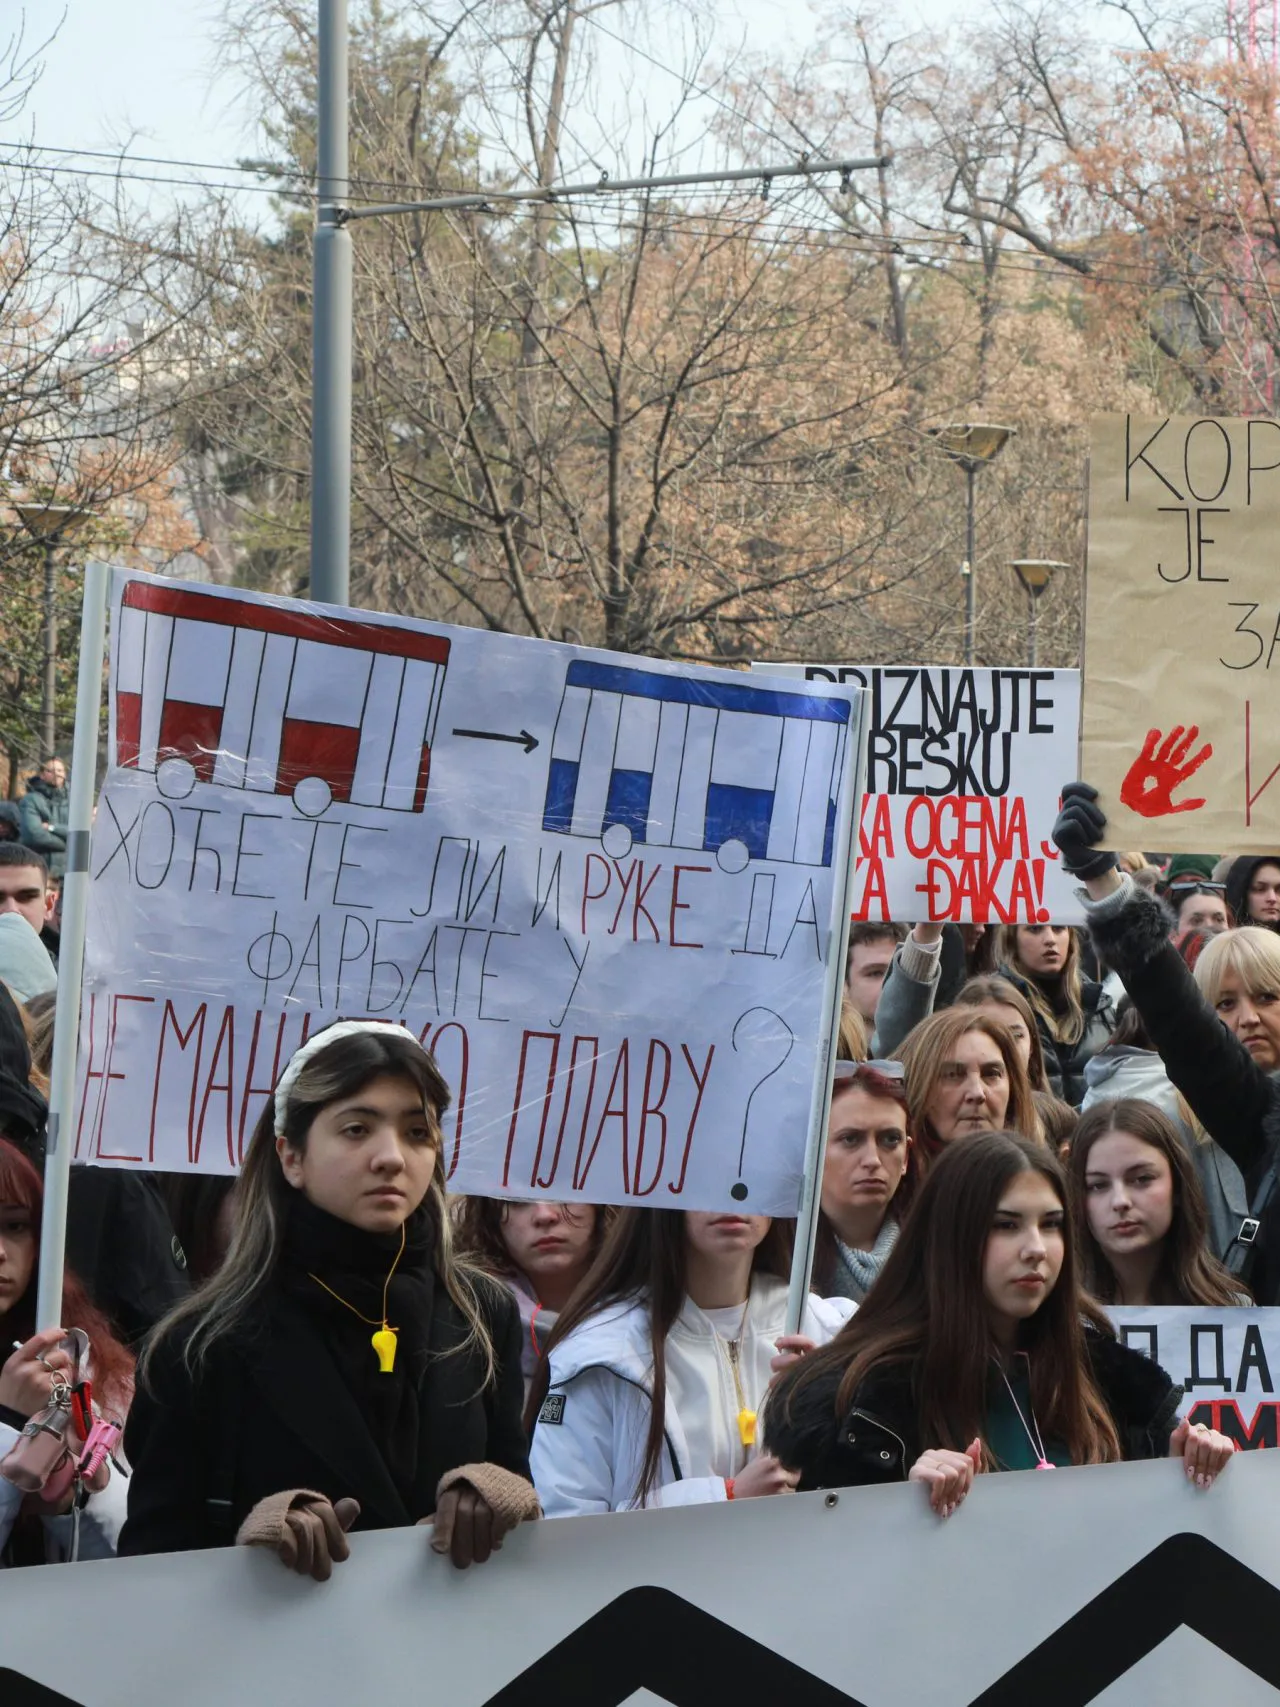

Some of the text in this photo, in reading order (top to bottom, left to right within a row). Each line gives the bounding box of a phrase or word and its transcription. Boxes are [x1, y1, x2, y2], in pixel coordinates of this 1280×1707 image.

[1157, 507, 1230, 583] ЈЕ
[805, 667, 1055, 734] IZNAJTE
[905, 795, 1030, 860] OCENA
[410, 836, 506, 924] ЛИ
[581, 852, 713, 948] РУКЕ
[731, 872, 823, 962] ДА
[915, 858, 1050, 924] ĐAKA!
[247, 910, 591, 1030] ФАРБАТЕ У
